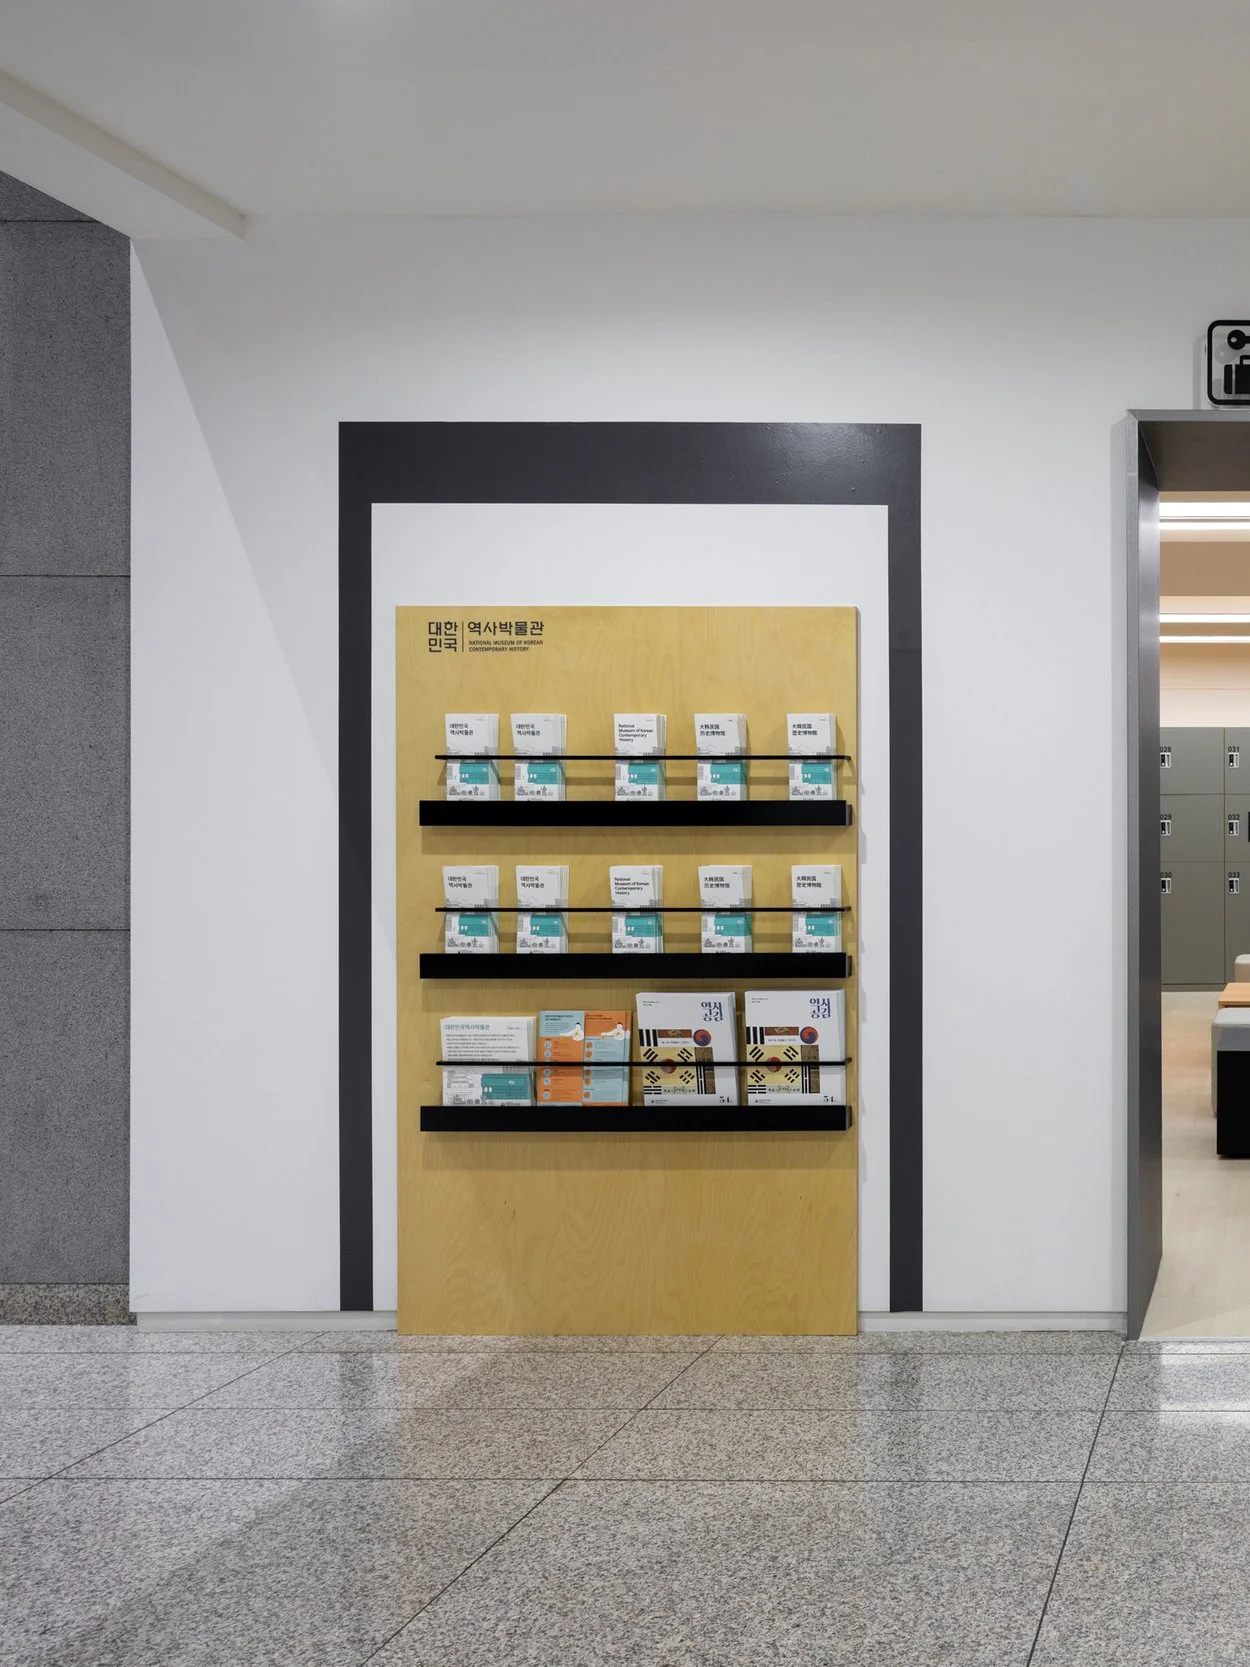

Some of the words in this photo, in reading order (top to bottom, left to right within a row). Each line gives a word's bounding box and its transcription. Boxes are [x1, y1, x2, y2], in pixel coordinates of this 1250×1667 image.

[428, 621, 458, 636] 대한
[468, 621, 544, 636] 역사박물관
[428, 638, 458, 652] 민국
